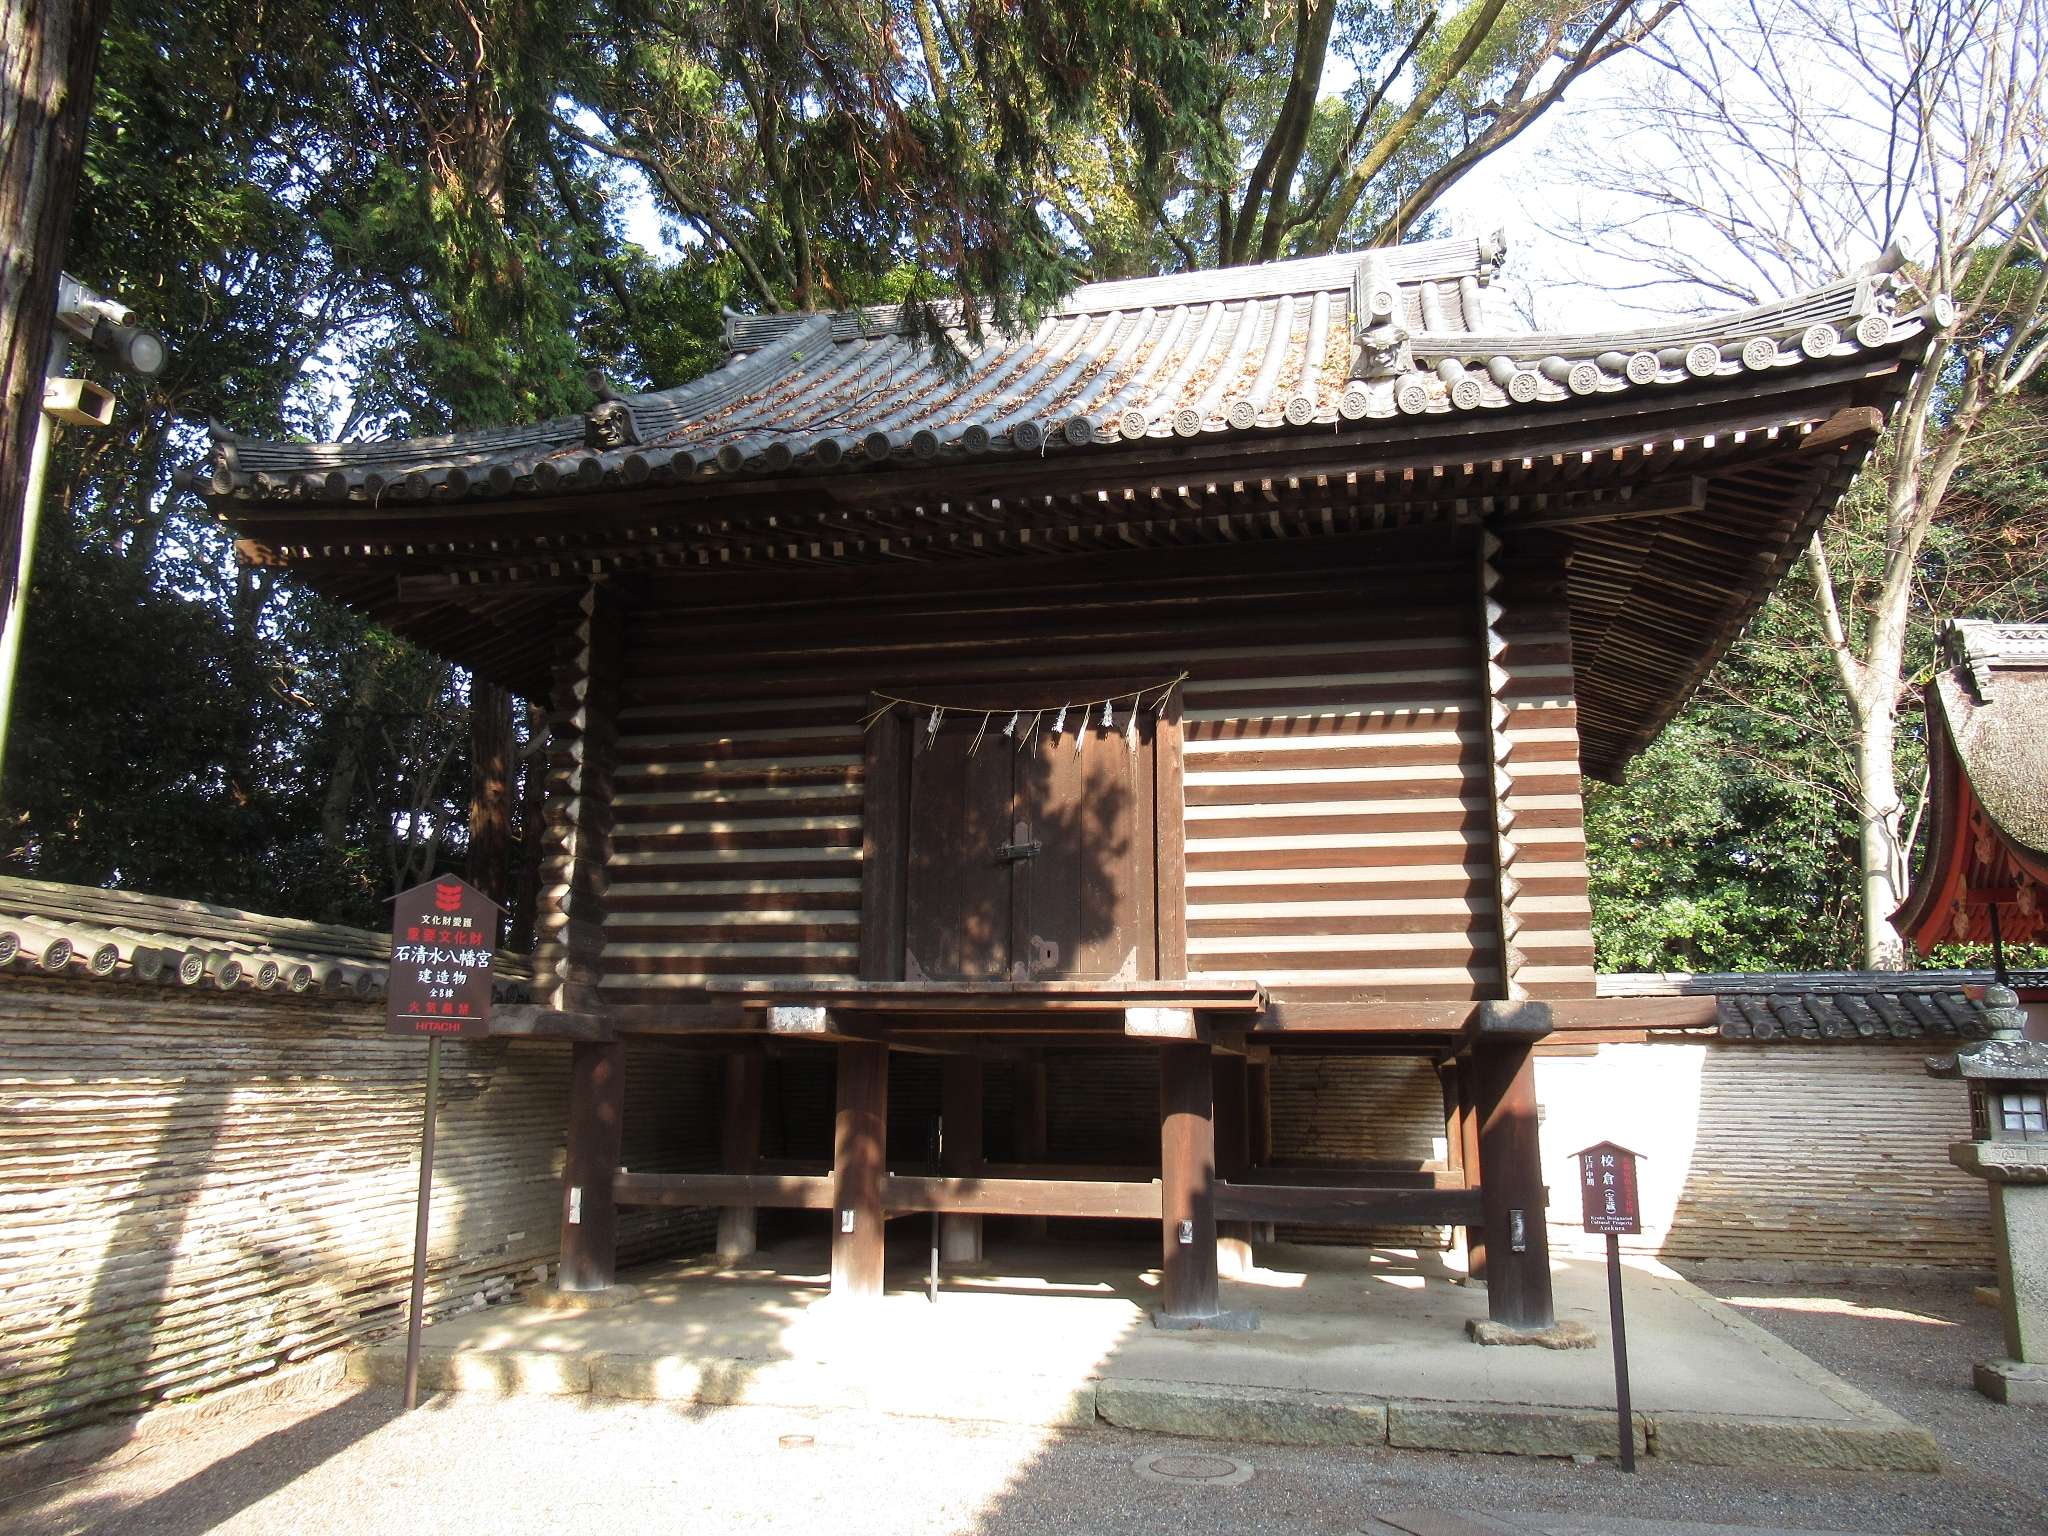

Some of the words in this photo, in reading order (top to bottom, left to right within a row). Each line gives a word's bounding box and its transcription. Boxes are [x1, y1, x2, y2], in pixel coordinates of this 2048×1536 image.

[394, 945, 492, 968] 石清水八幡宮
[417, 969, 467, 985] 建造物
[415, 1021, 461, 1032] HITACHI
